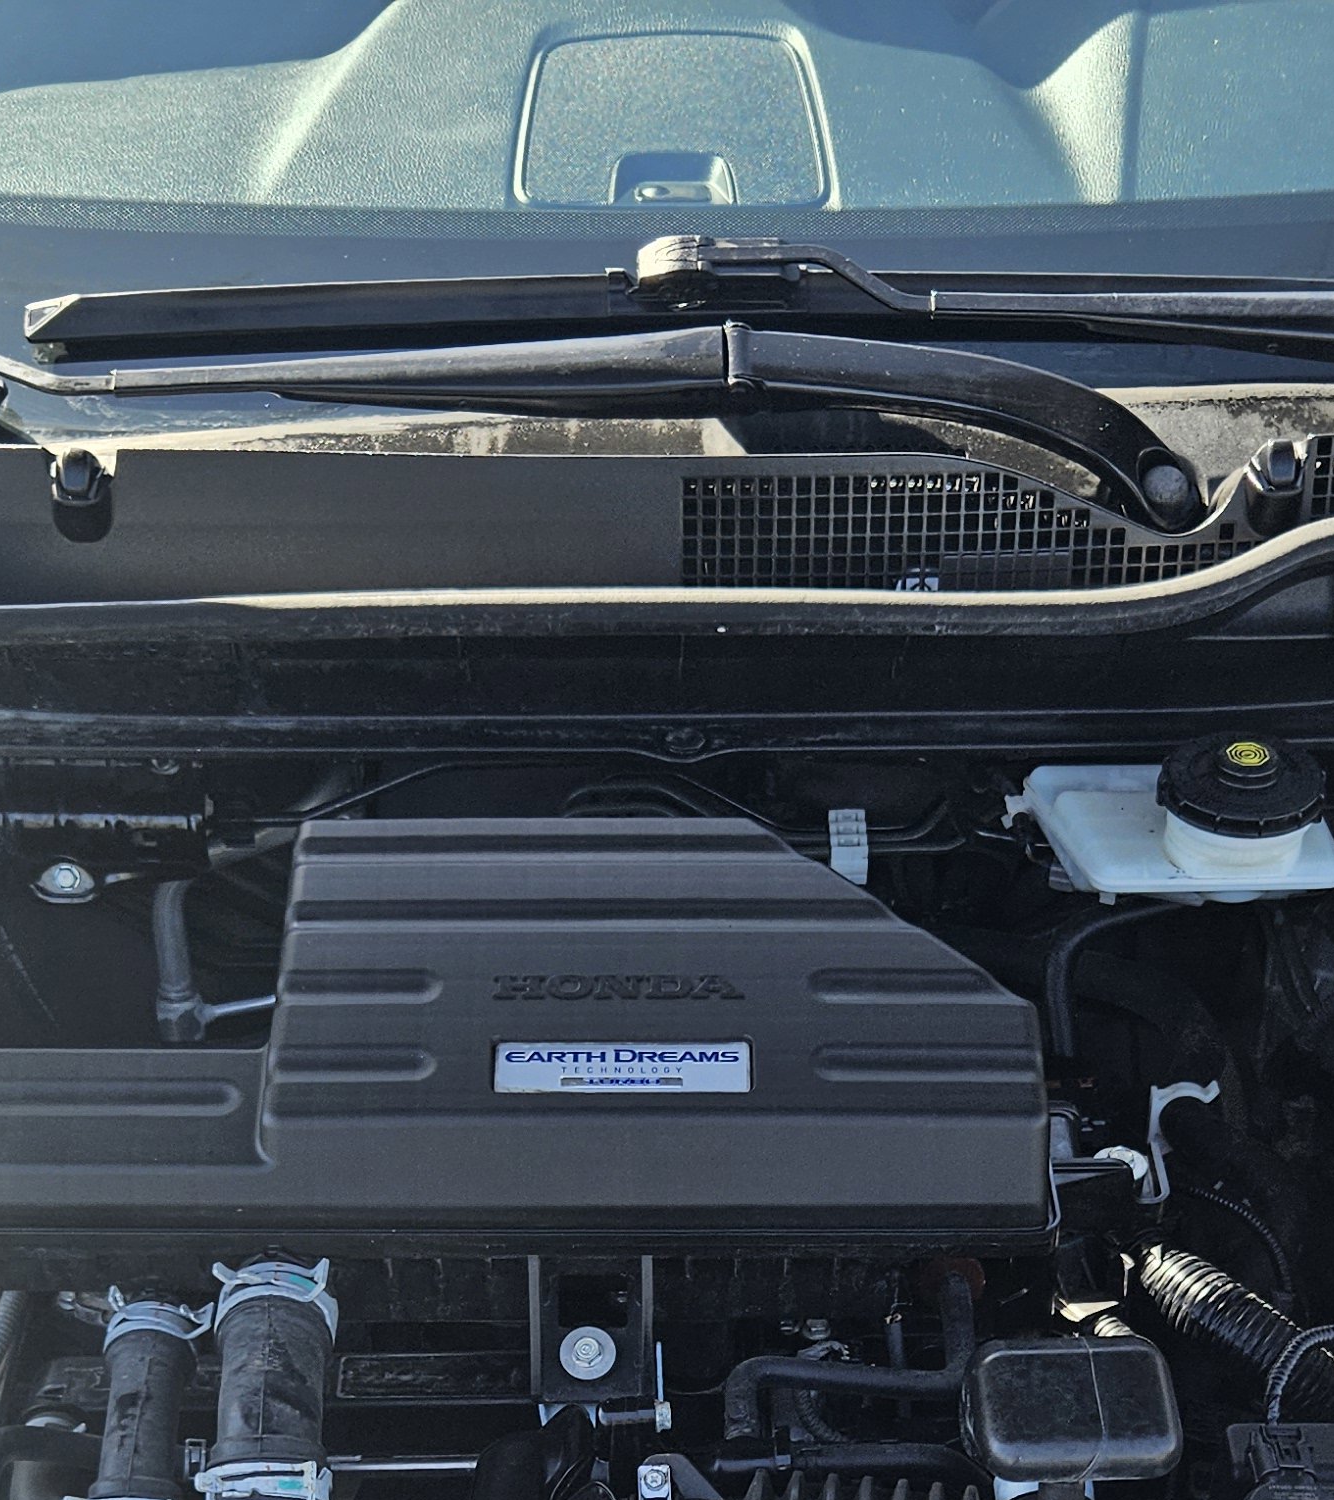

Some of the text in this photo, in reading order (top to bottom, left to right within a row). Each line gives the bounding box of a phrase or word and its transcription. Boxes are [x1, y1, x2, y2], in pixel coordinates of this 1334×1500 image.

[491, 974, 746, 1001] HONDA
[504, 1048, 740, 1064] EARTH DREAMS
[561, 1066, 683, 1075] TECHNOLOGY
